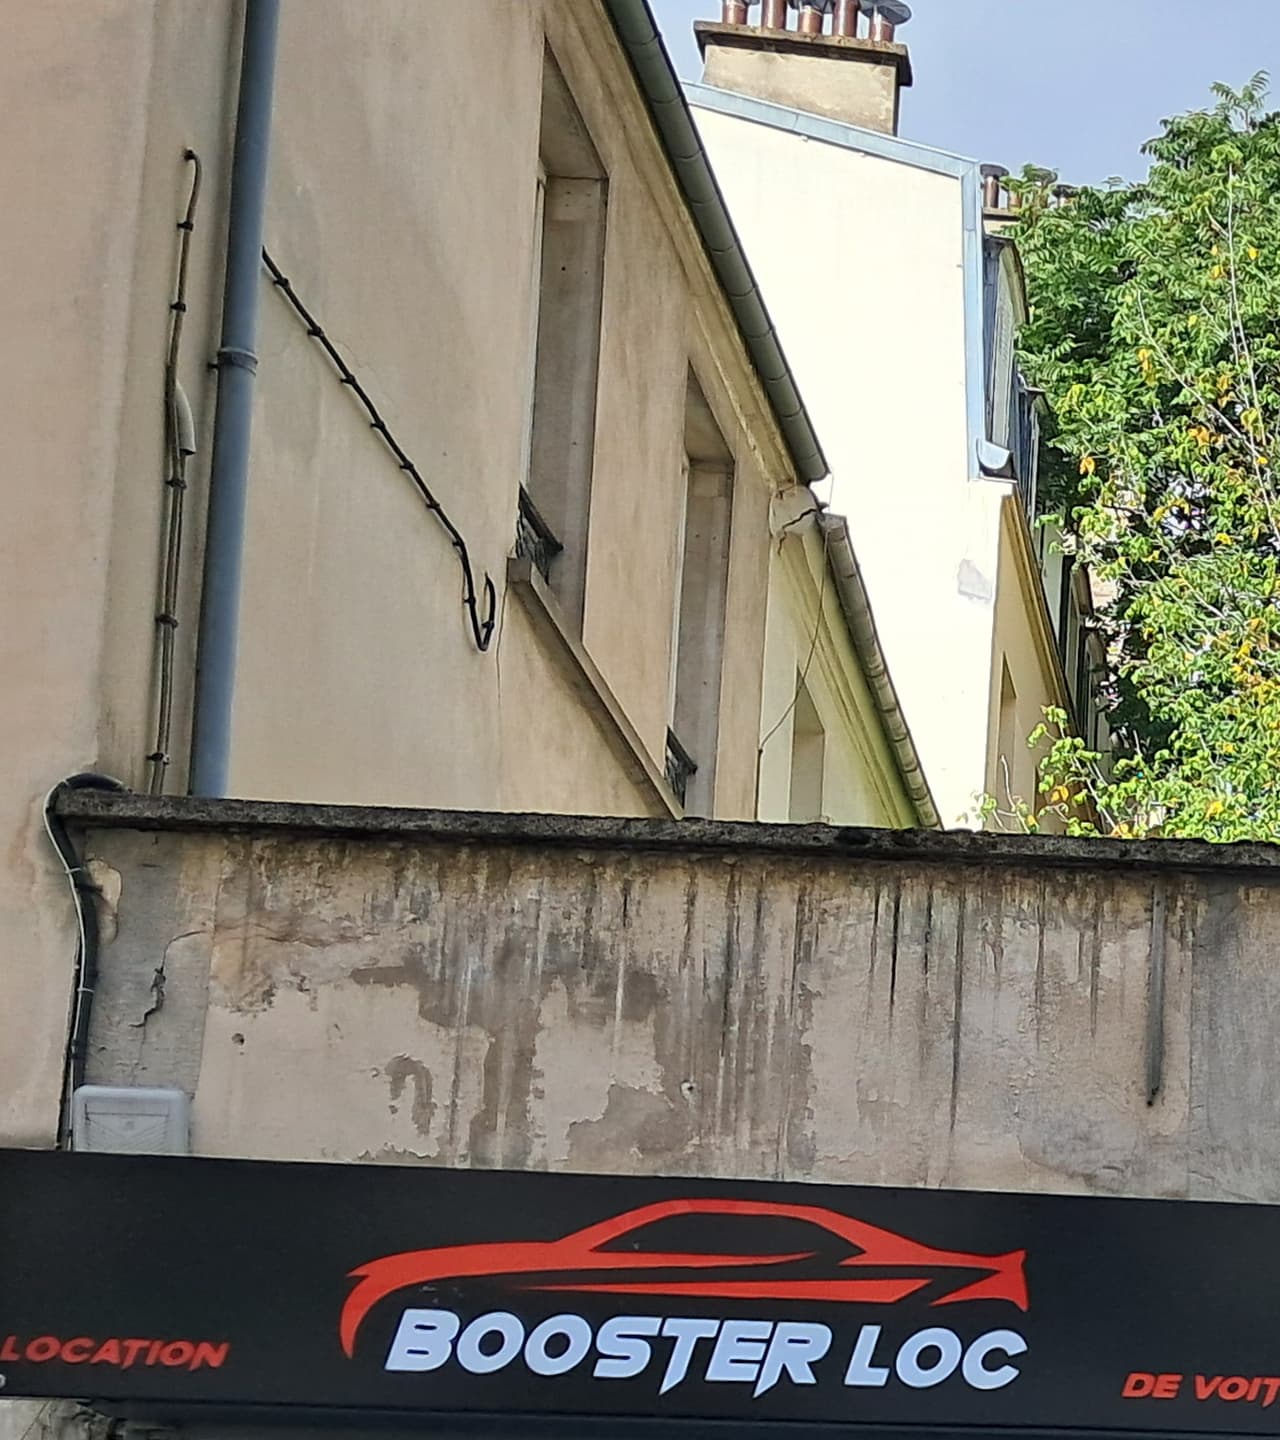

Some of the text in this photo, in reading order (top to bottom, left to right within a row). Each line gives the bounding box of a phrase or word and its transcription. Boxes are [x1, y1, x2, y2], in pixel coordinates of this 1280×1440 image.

[1, 1335, 231, 1372] LOCATION
[384, 1307, 1028, 1398] BOOSTER LOC
[1121, 1373, 1184, 1400] DE
